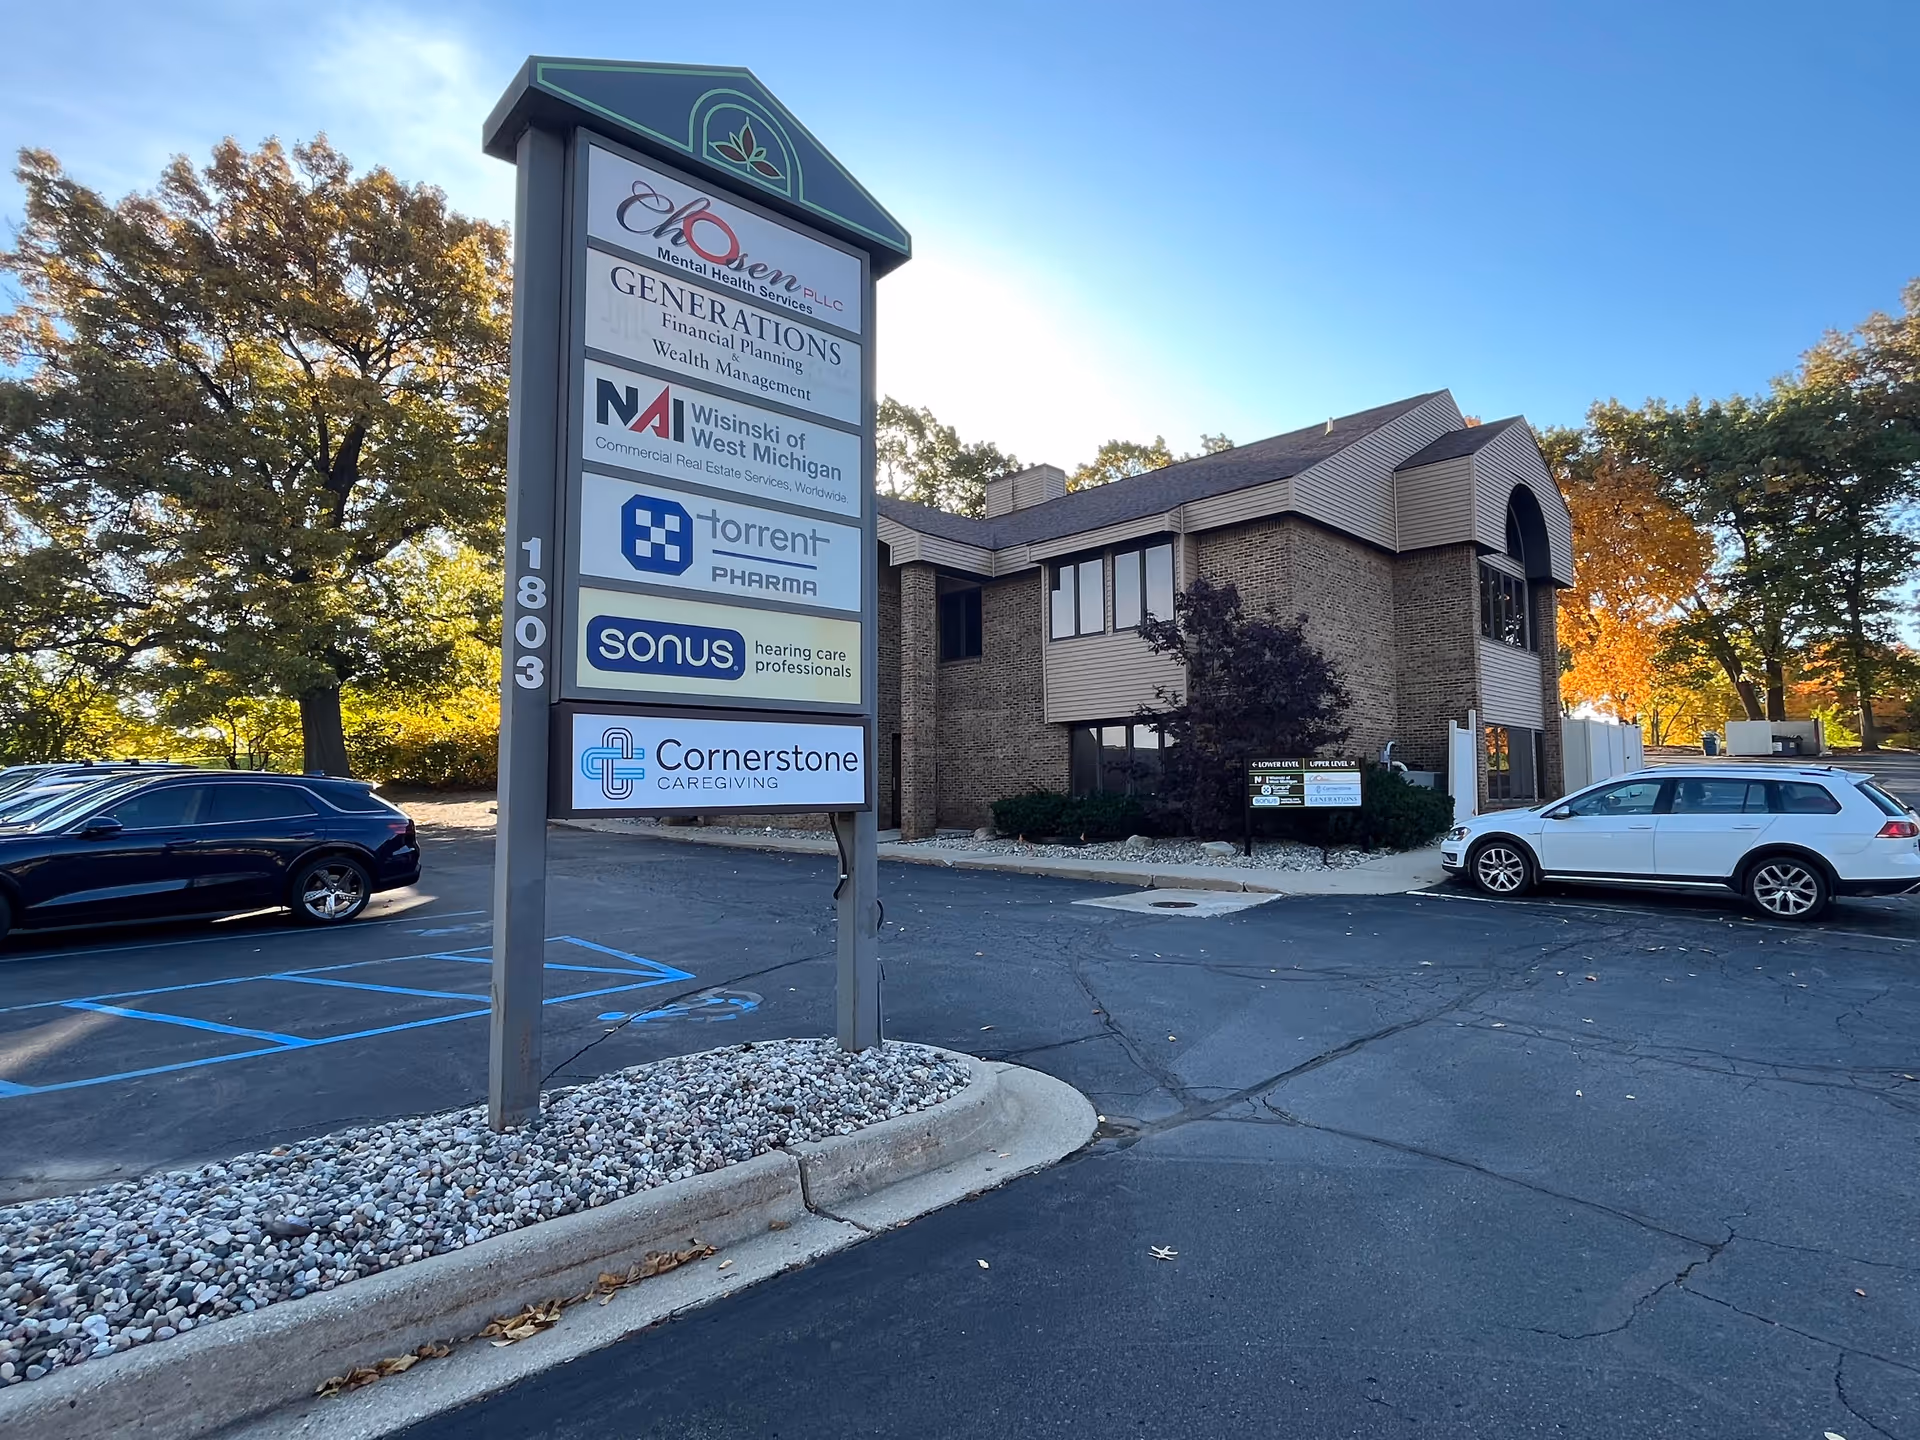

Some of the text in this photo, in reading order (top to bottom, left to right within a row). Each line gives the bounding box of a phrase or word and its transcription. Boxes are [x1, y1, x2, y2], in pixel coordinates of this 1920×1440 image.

[657, 246, 813, 315] Mental Health Services
[803, 287, 844, 312] PLLC
[610, 266, 841, 366] GENERATIONS
[661, 312, 804, 375] Financial Planning
[731, 353, 740, 362] &
[652, 338, 811, 401] Wealth Management
[596, 377, 684, 443] NAI
[690, 402, 806, 450] Wisinski of
[595, 436, 849, 504] Commercial Real Estate Services, Worldwide.
[690, 427, 842, 481] West Michigan
[696, 508, 830, 557] torrent
[711, 565, 818, 597] PHARMA
[515, 537, 547, 690] 1803
[755, 640, 847, 662] hearing care
[755, 659, 852, 678] professionals
[656, 738, 859, 773] Cornerstone
[1309, 760, 1330, 768] UPPER
[657, 776, 779, 790] CAREGIVING
